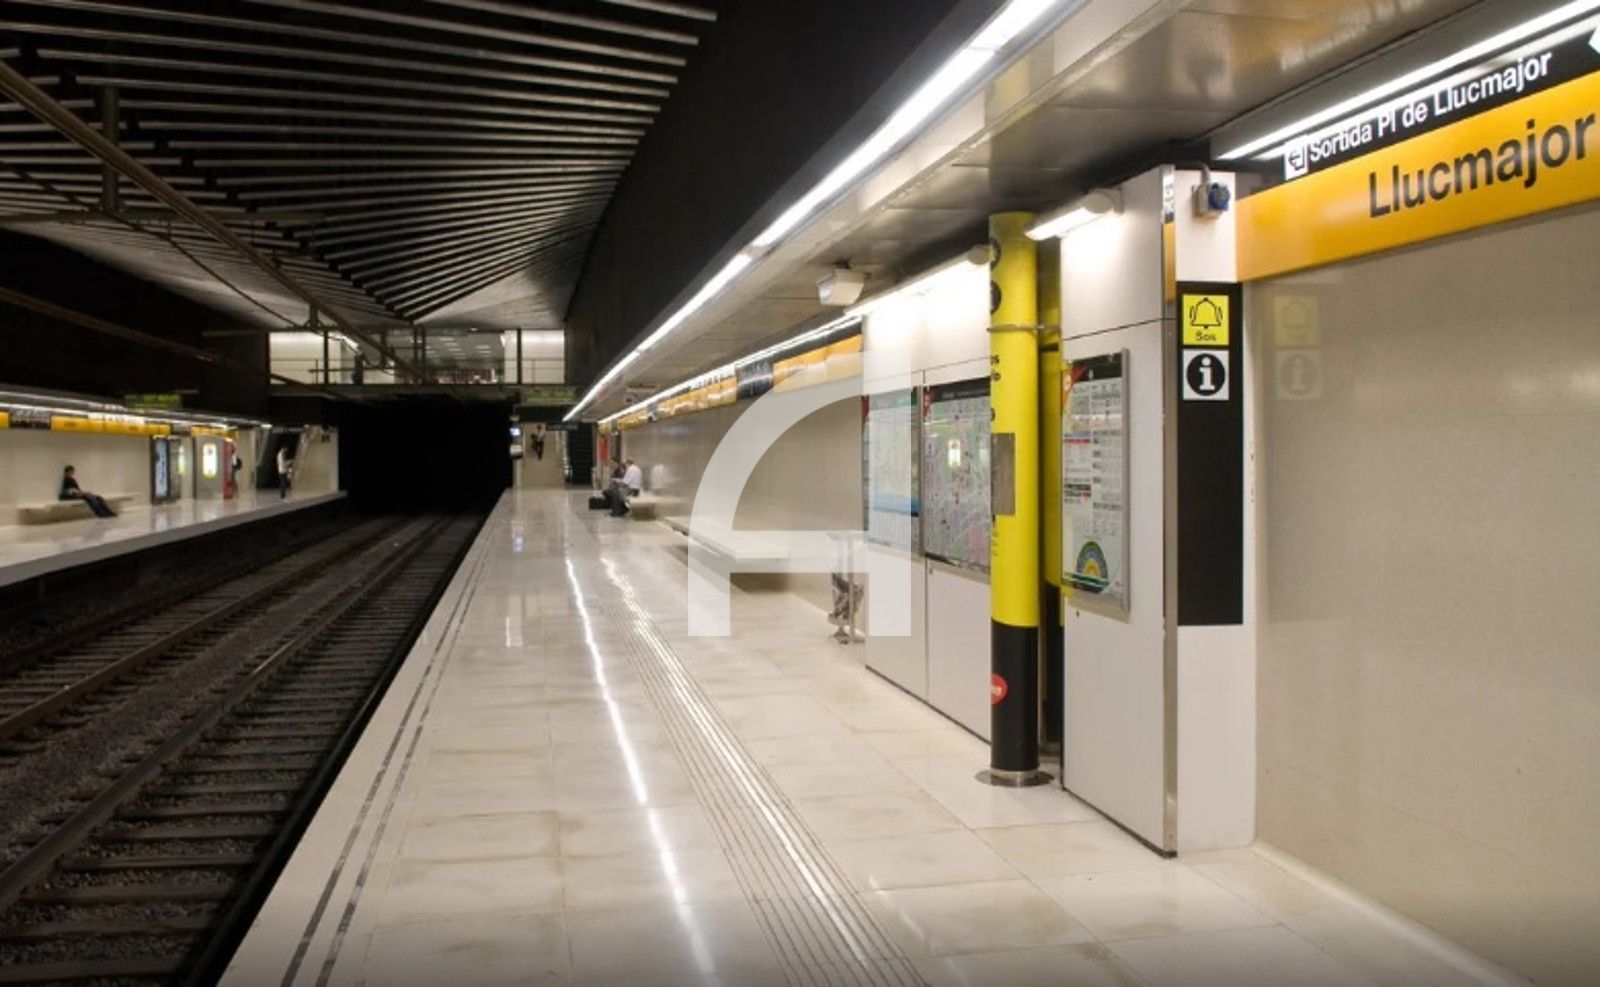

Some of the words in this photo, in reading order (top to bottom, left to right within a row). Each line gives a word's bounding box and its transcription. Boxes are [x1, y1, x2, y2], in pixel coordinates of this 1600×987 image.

[1310, 121, 1373, 163] Sortida
[1402, 100, 1429, 128] de
[1433, 51, 1553, 117] Llucmajor
[1369, 113, 1596, 218] Llucmajor
